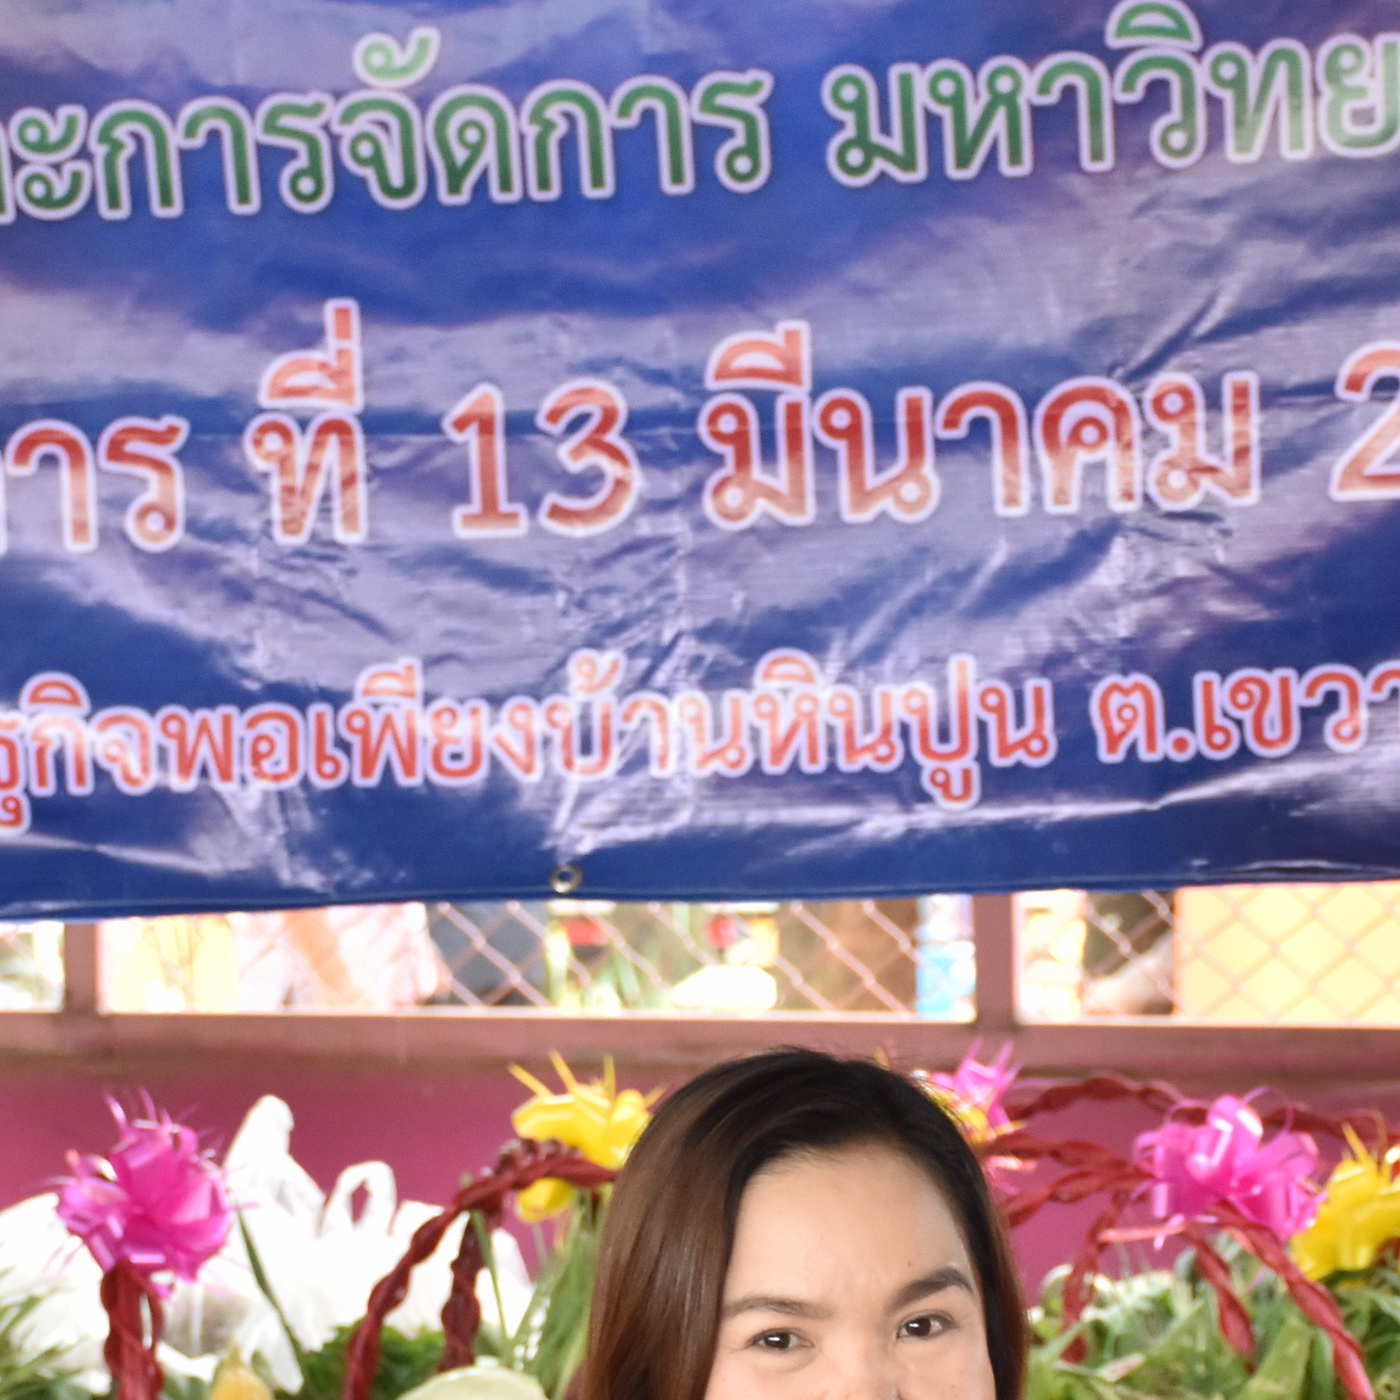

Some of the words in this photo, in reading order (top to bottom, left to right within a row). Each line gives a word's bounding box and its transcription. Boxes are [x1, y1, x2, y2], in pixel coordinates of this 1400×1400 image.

[245, 299, 370, 546] ที่
[442, 375, 641, 542] 13
[698, 320, 1262, 528] มีนาคม
